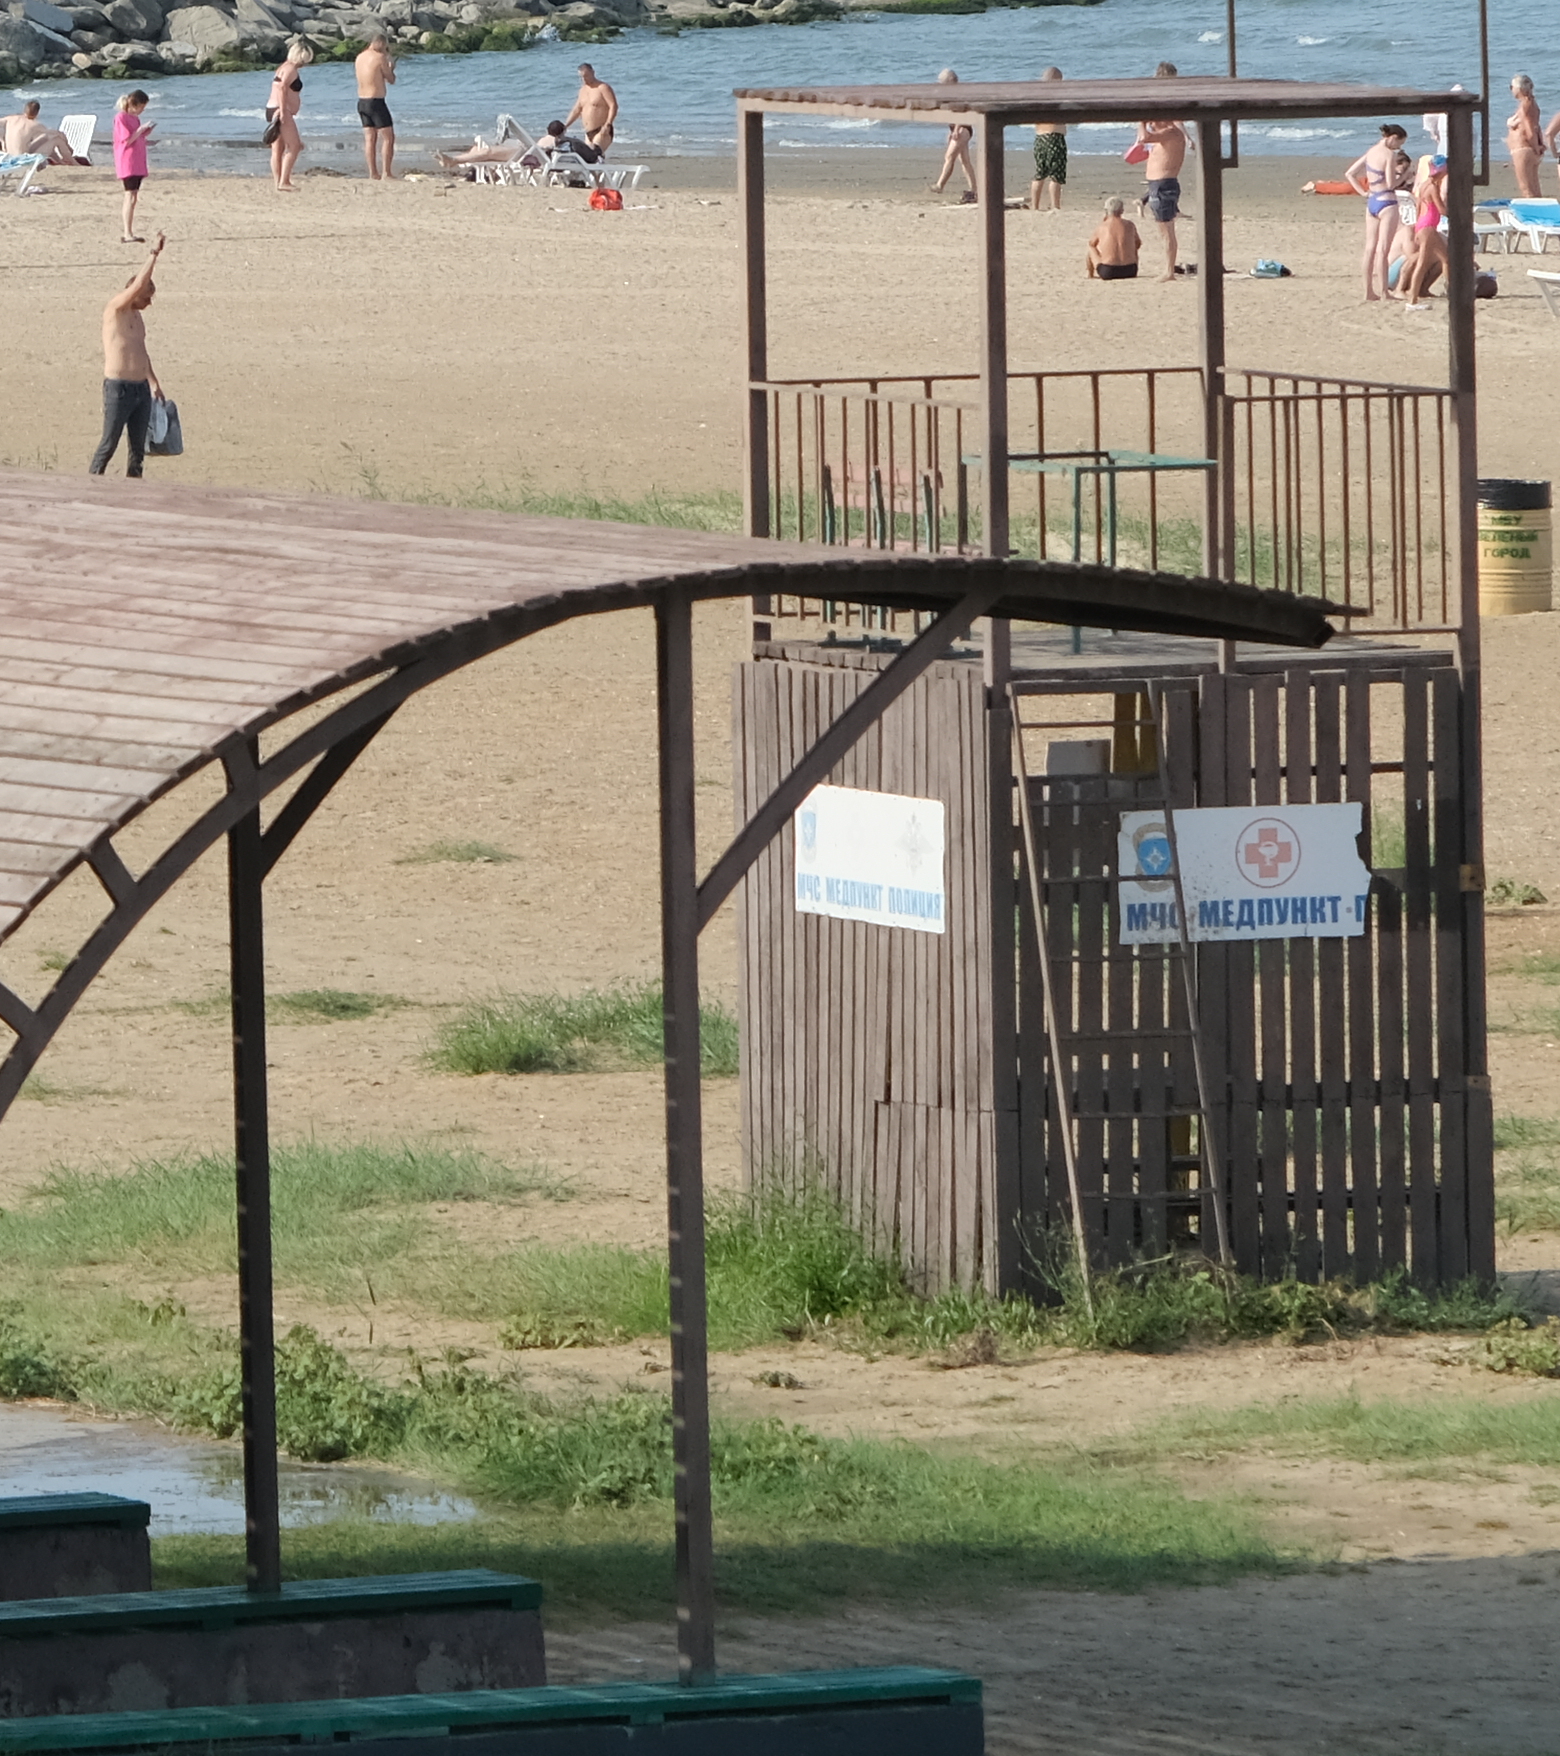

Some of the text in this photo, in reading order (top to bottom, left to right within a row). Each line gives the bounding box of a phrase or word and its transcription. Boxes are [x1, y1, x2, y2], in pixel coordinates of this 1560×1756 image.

[1484, 547, 1531, 559] ГОРОД
[797, 872, 942, 921] МЧС МЕДПУНКТ ПОЛИЦИЯ
[1198, 895, 1342, 930] МЕДПУНКТ
